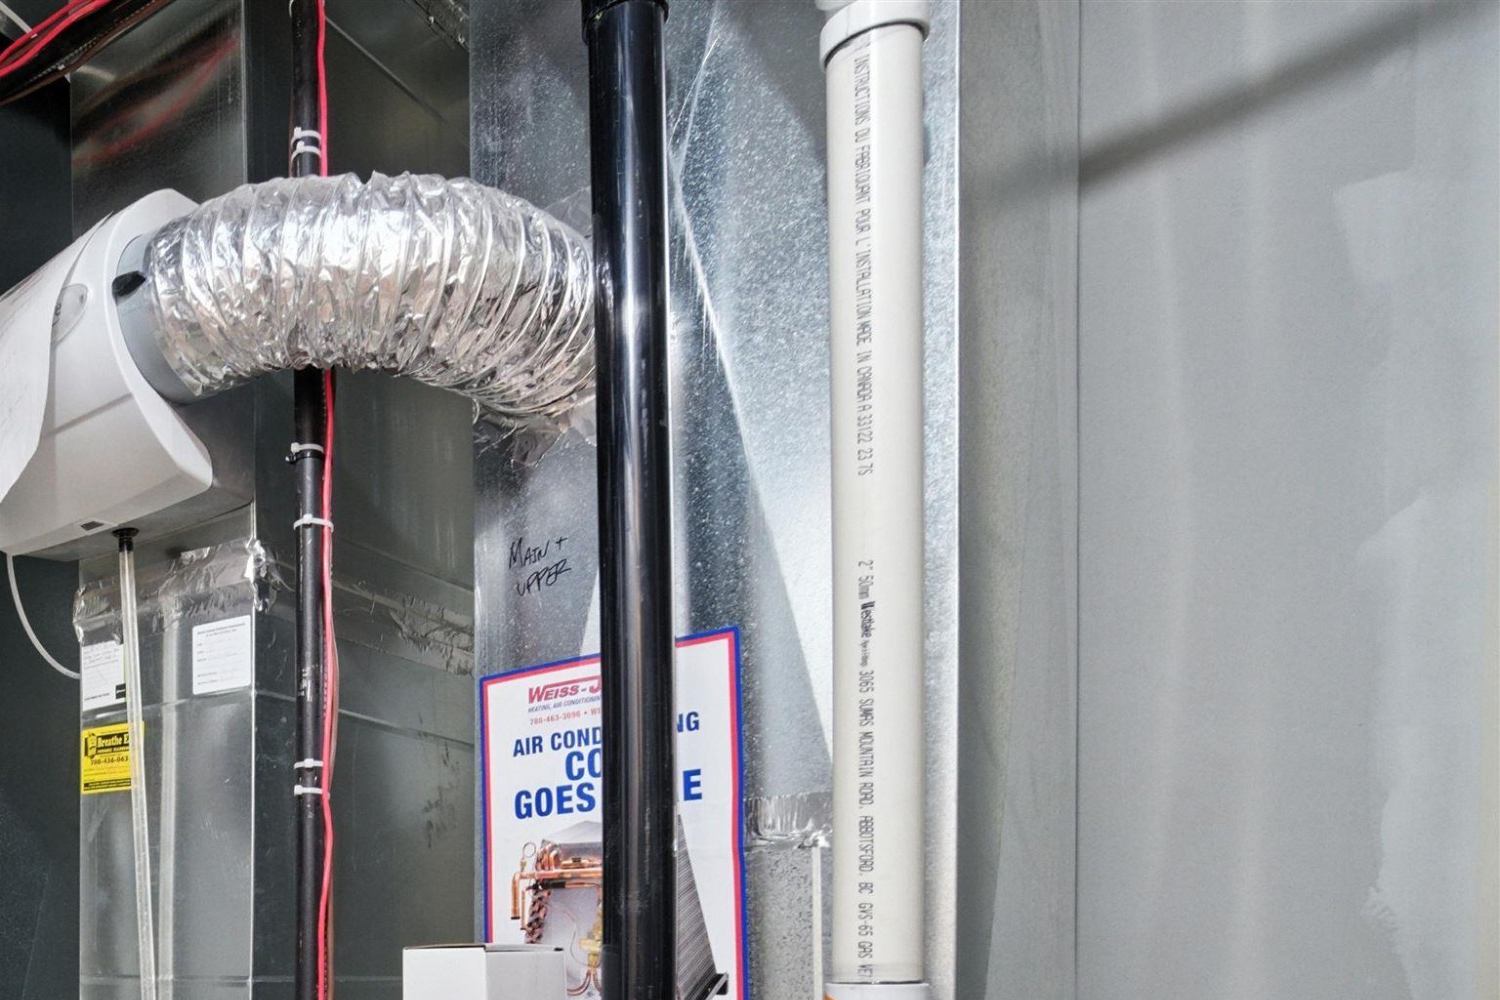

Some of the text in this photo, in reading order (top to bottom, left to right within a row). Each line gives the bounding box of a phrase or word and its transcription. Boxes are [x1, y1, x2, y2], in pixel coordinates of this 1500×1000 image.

[852, 53, 870, 126] INSTRUCTIONS
[854, 209, 871, 233] POUR
[857, 669, 873, 693] 3065
[857, 698, 873, 726] SUMAS
[513, 738, 543, 757] AIR
[857, 731, 874, 777] MOUNTAIN
[515, 782, 596, 820] GOES
[858, 881, 874, 894] BC
[857, 902, 873, 936] GVS-65
[857, 940, 874, 958] GAS
